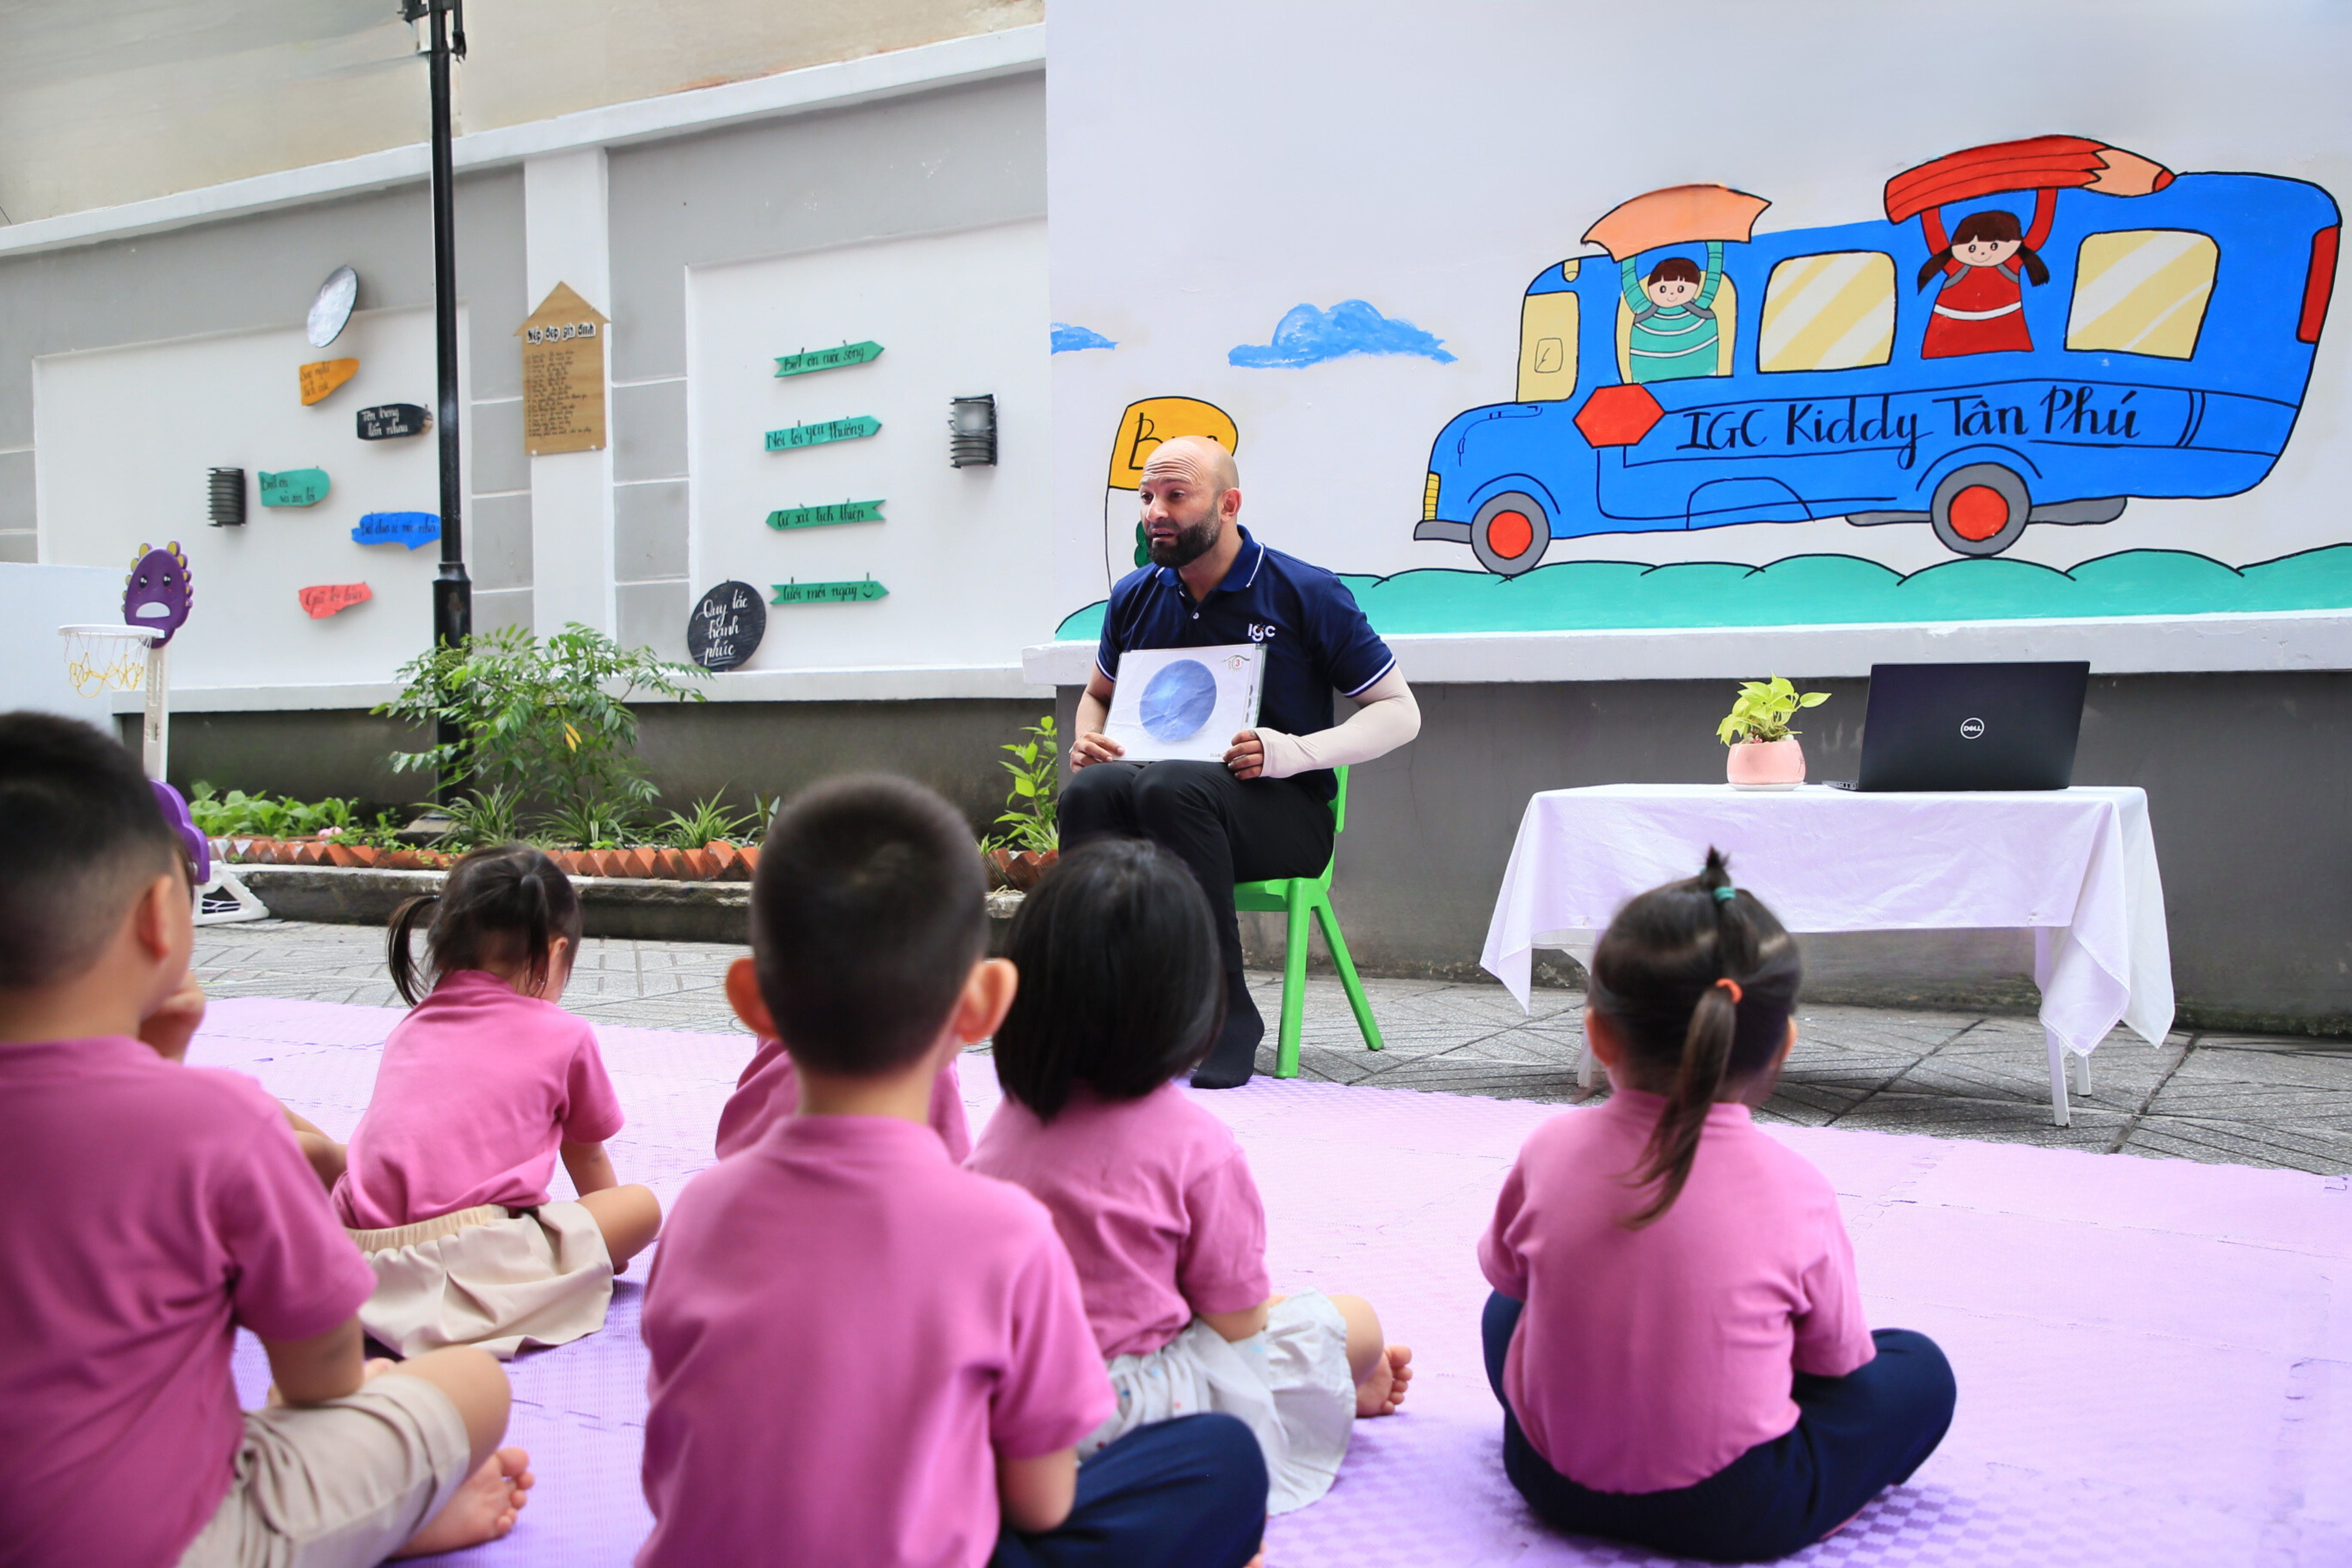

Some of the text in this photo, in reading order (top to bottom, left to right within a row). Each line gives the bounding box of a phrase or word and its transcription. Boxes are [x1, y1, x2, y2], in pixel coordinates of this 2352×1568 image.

[1676, 385, 2141, 470] IGC Kiddy Tân Phú
[695, 598, 728, 628] Quy
[704, 638, 736, 665] phúc
